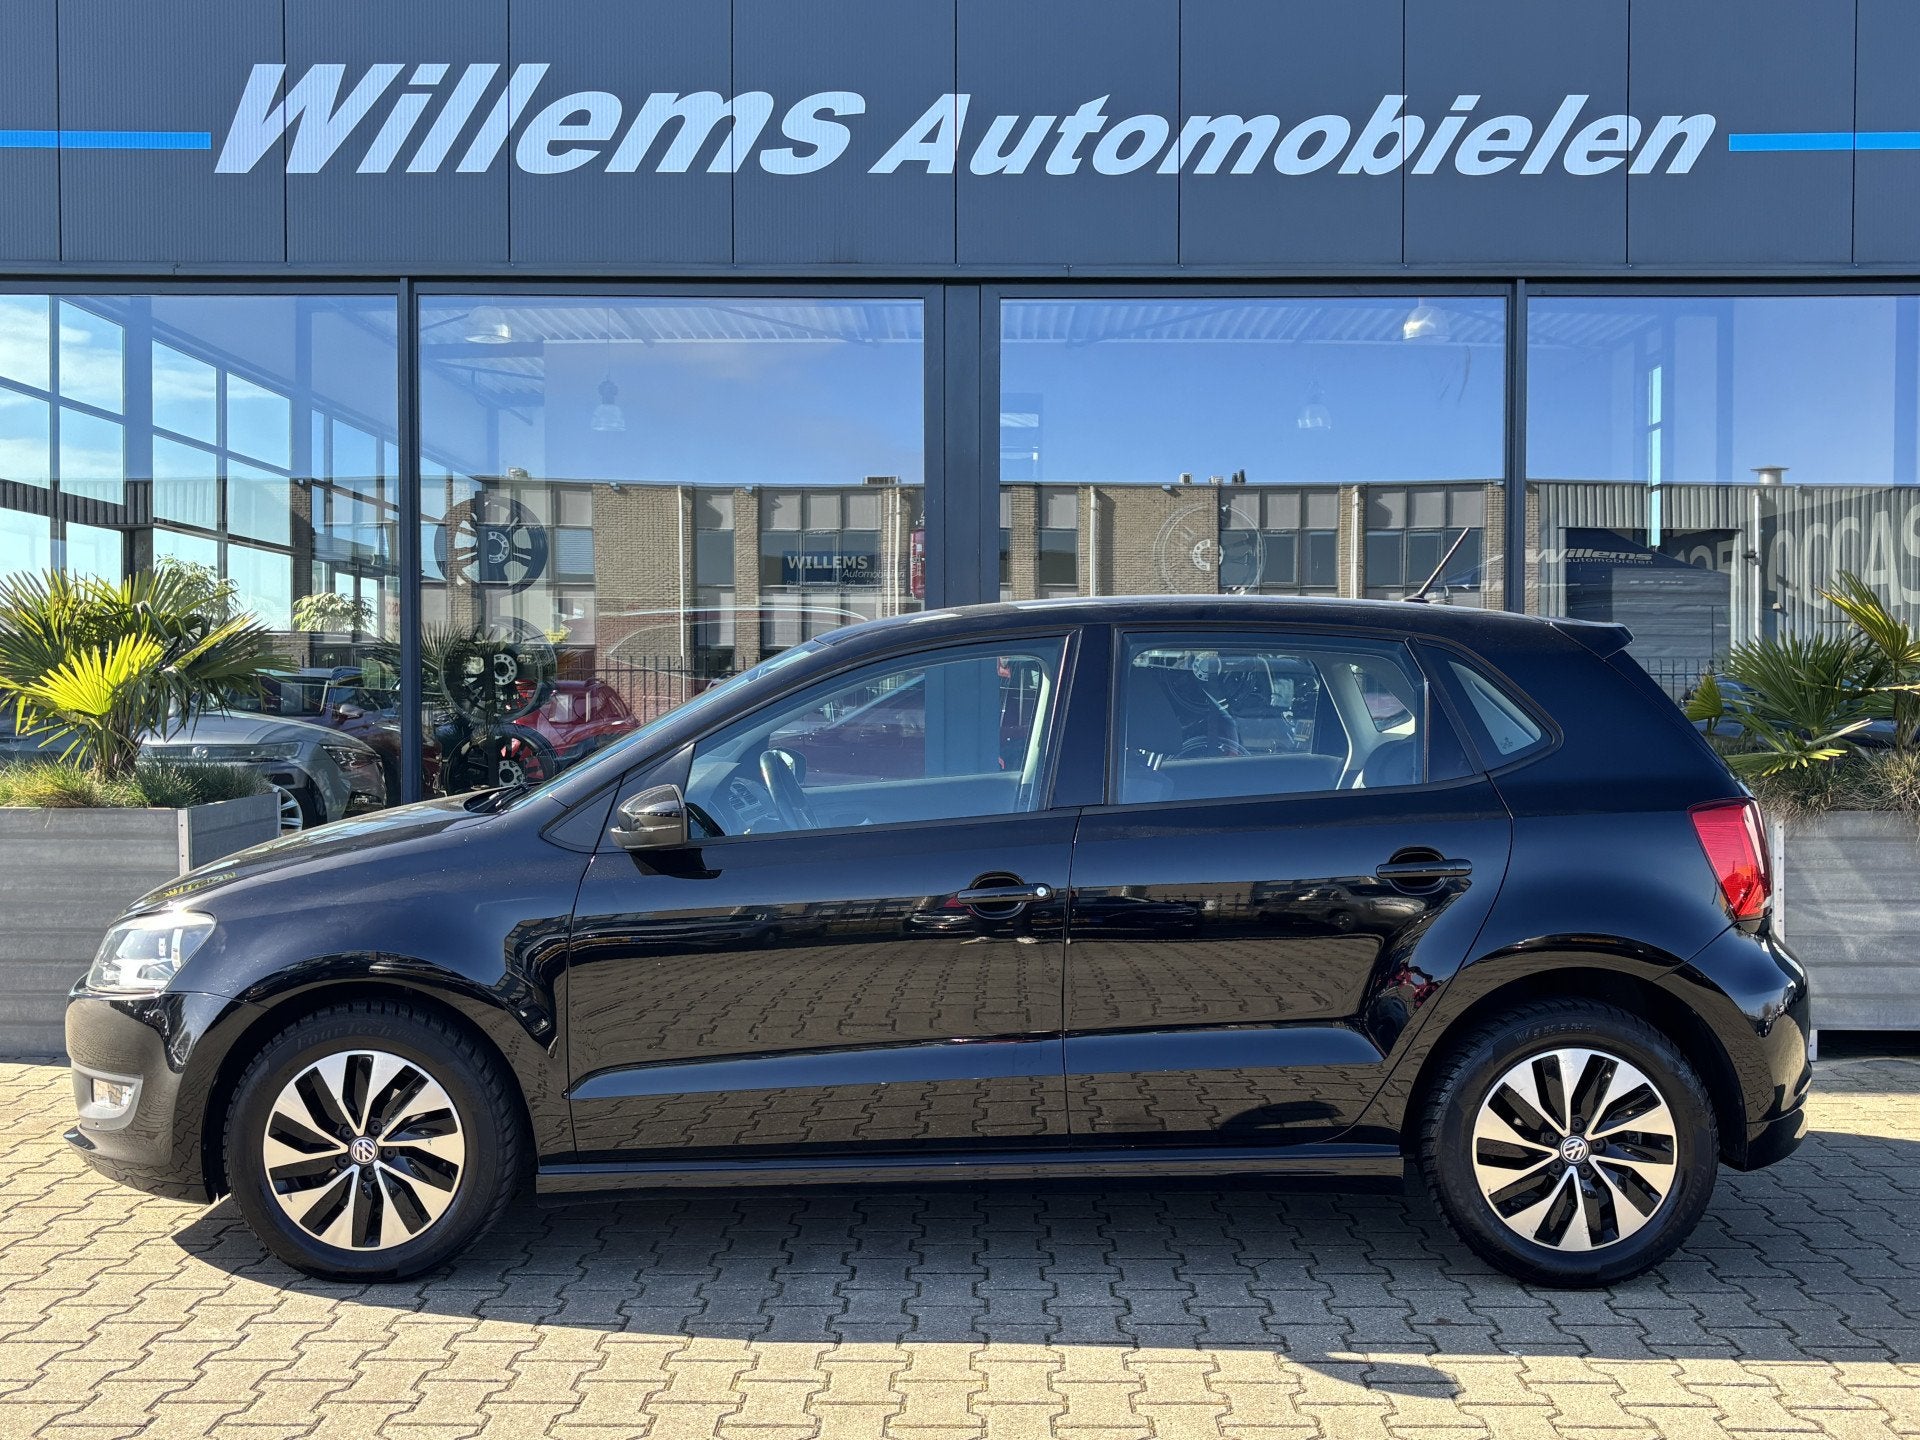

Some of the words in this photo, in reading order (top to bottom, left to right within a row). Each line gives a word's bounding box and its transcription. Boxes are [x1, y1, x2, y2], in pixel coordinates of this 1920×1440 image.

[214, 63, 866, 175] Willems
[867, 93, 1716, 176] Automobielen
[787, 555, 868, 570] WILLEMS
[1525, 548, 1653, 563] Willems
